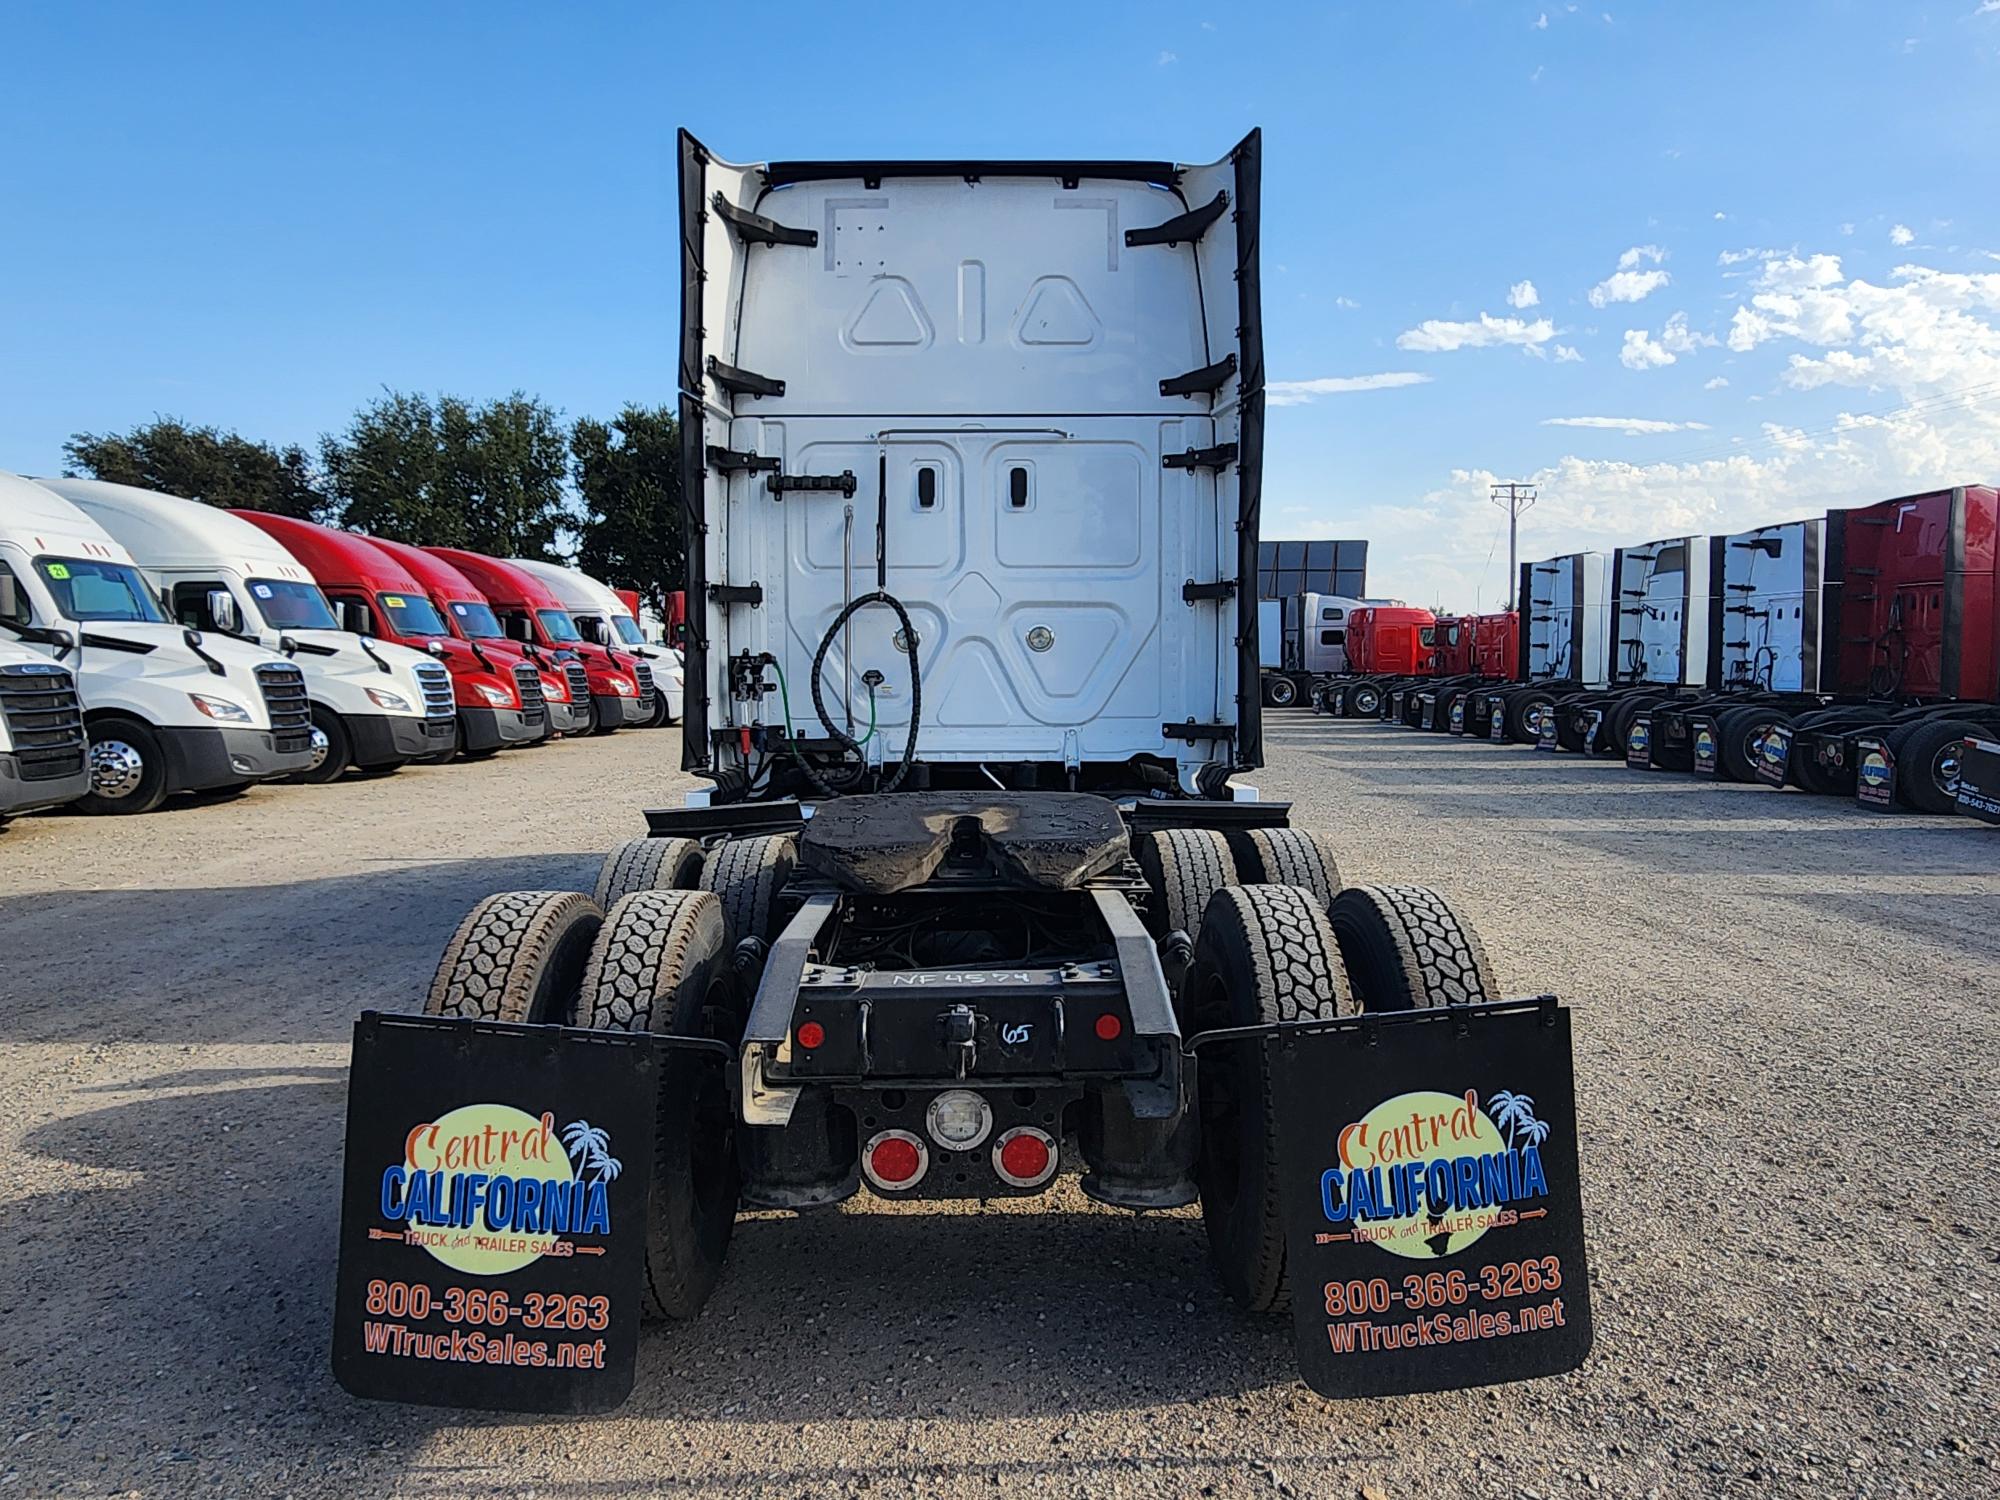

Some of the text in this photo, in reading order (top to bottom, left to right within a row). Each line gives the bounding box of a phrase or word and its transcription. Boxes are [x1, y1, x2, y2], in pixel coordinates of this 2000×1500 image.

[1002, 1022, 1034, 1045] 65
[405, 1111, 555, 1174] Central
[1337, 1088, 1483, 1172] Central
[381, 1165, 610, 1235] CALIFORNIA
[1320, 1145, 1549, 1222] CALIFORNIA
[404, 1229, 574, 1257] TRUCK and TRAILER SALES
[1351, 1209, 1519, 1243] TRUCK and TRAILER SALES
[366, 1279, 610, 1330] 800-366-3263
[1324, 1255, 1562, 1316] 800-366-3263
[363, 1321, 606, 1369] WTruckSales.net
[1327, 1297, 1566, 1353] WTruckSales.net
